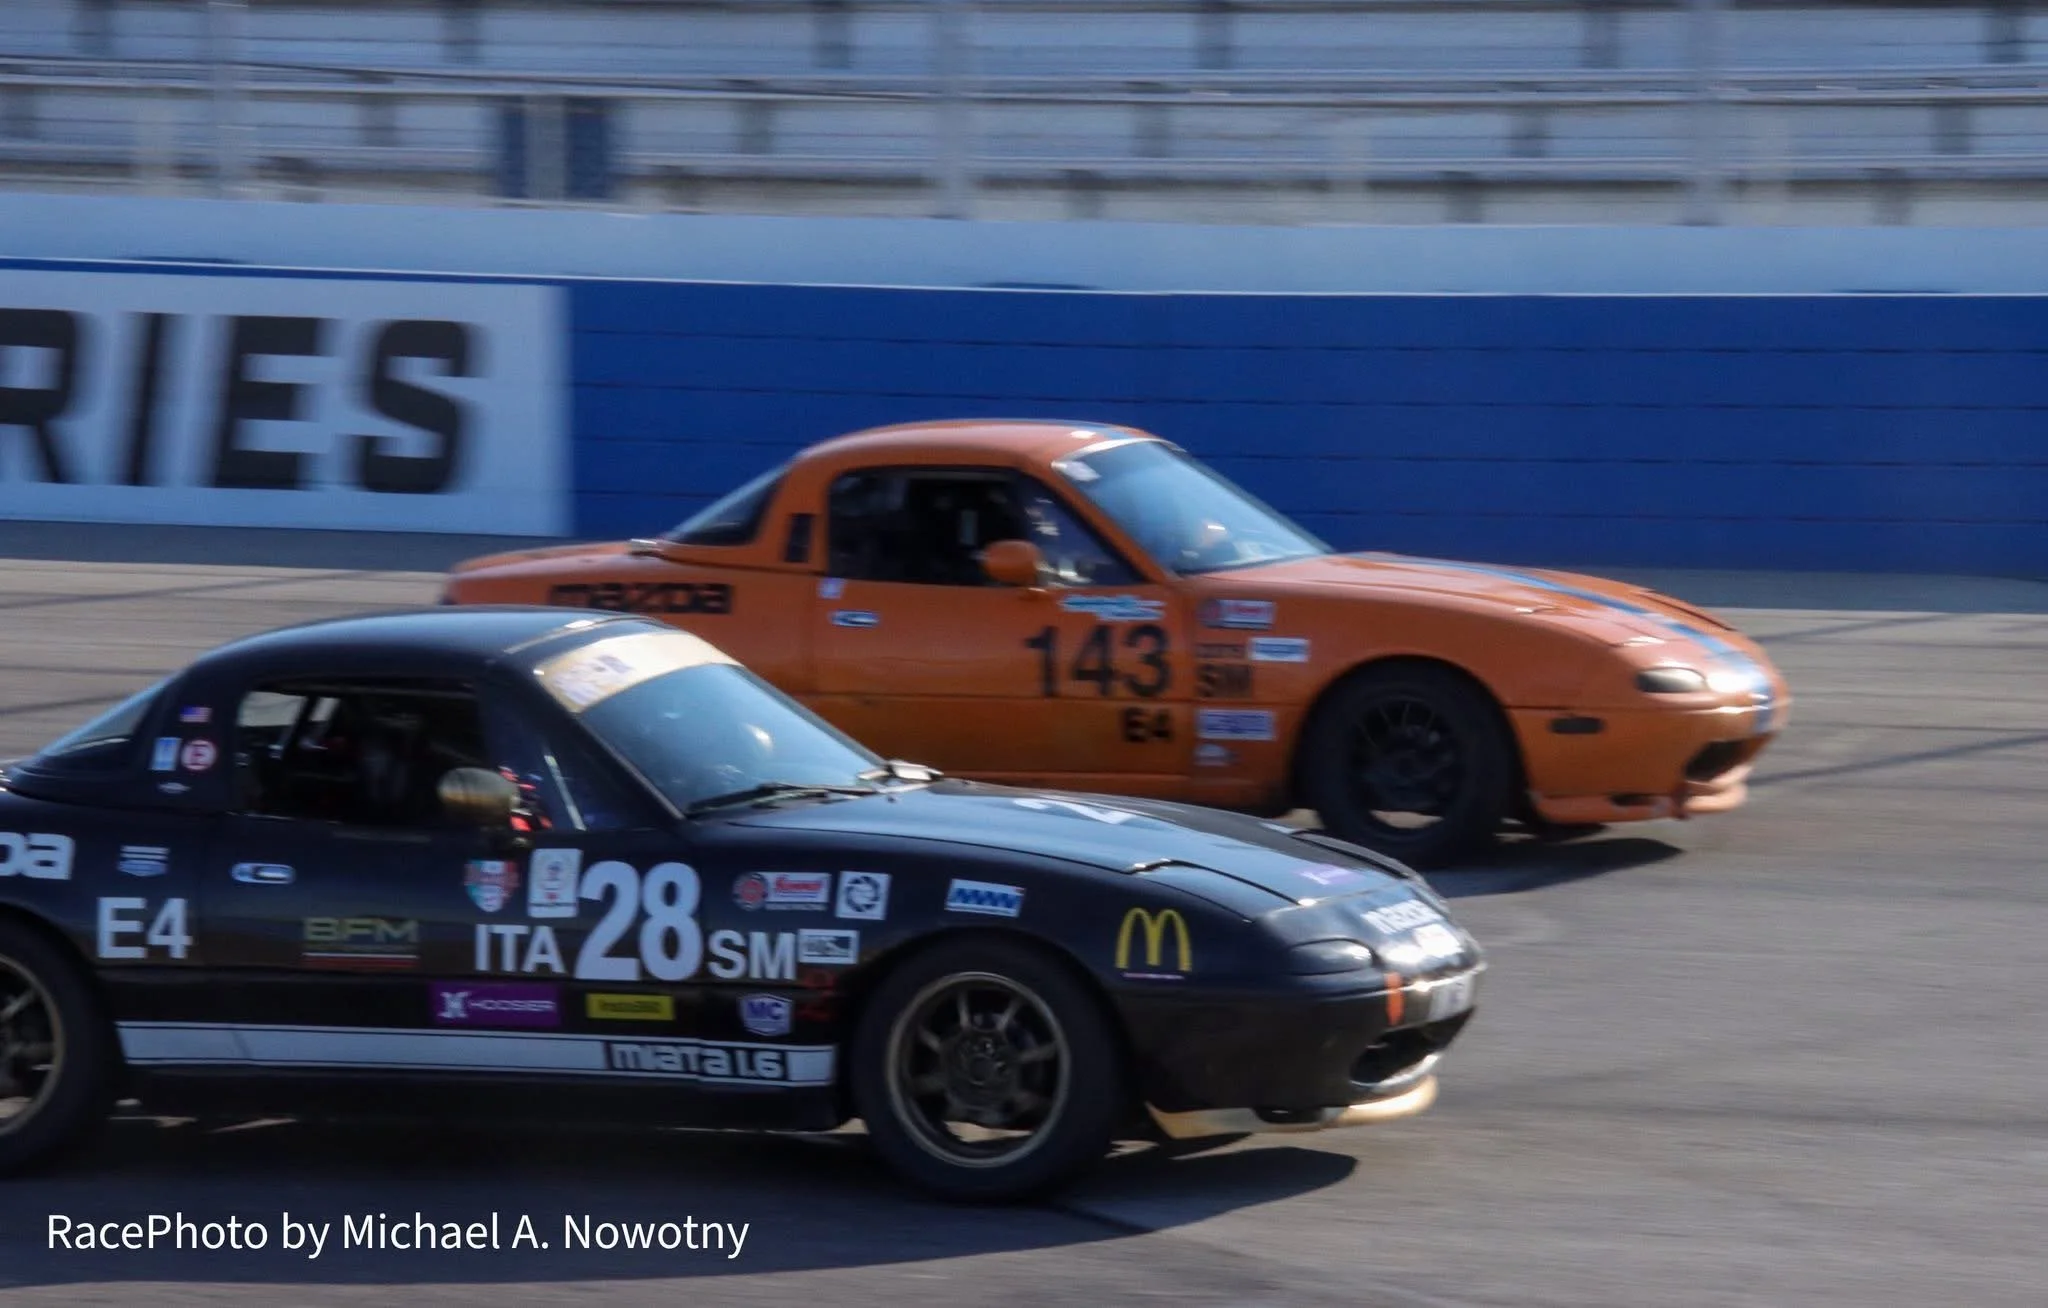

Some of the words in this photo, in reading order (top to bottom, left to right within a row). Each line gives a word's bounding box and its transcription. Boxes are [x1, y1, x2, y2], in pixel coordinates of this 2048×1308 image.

[0, 308, 488, 495] RIES
[1024, 624, 1171, 697] 143
[1122, 707, 1174, 743] E4
[97, 896, 194, 960] E4
[302, 917, 419, 943] BFM
[474, 923, 566, 973] ITA
[575, 860, 702, 982] 28
[707, 929, 798, 981] SM
